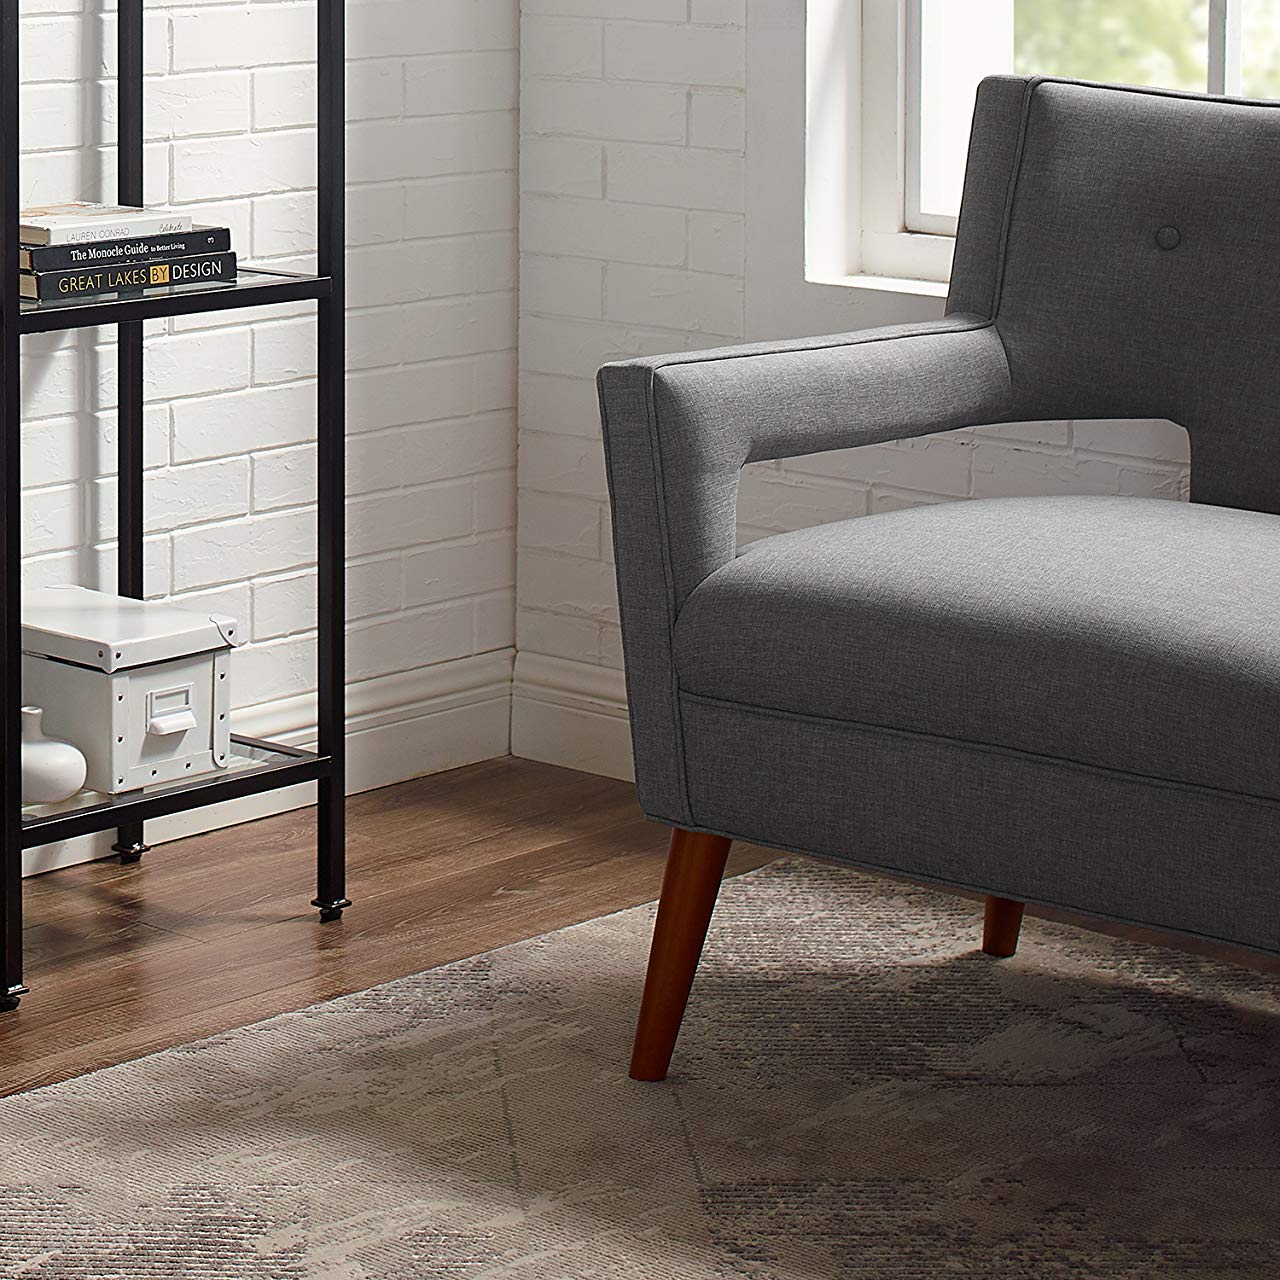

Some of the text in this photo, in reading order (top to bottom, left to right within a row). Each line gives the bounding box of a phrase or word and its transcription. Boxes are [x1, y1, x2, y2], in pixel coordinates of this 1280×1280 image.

[66, 227, 130, 242] LAUREN CONRAD
[70, 249, 87, 261] The
[87, 247, 124, 260] Monocle
[124, 243, 149, 256] Guide
[170, 242, 186, 250] Living
[58, 273, 103, 293] GREAT
[108, 269, 147, 287] LAKES
[152, 267, 168, 282] BY
[172, 260, 222, 280] DESIGN
